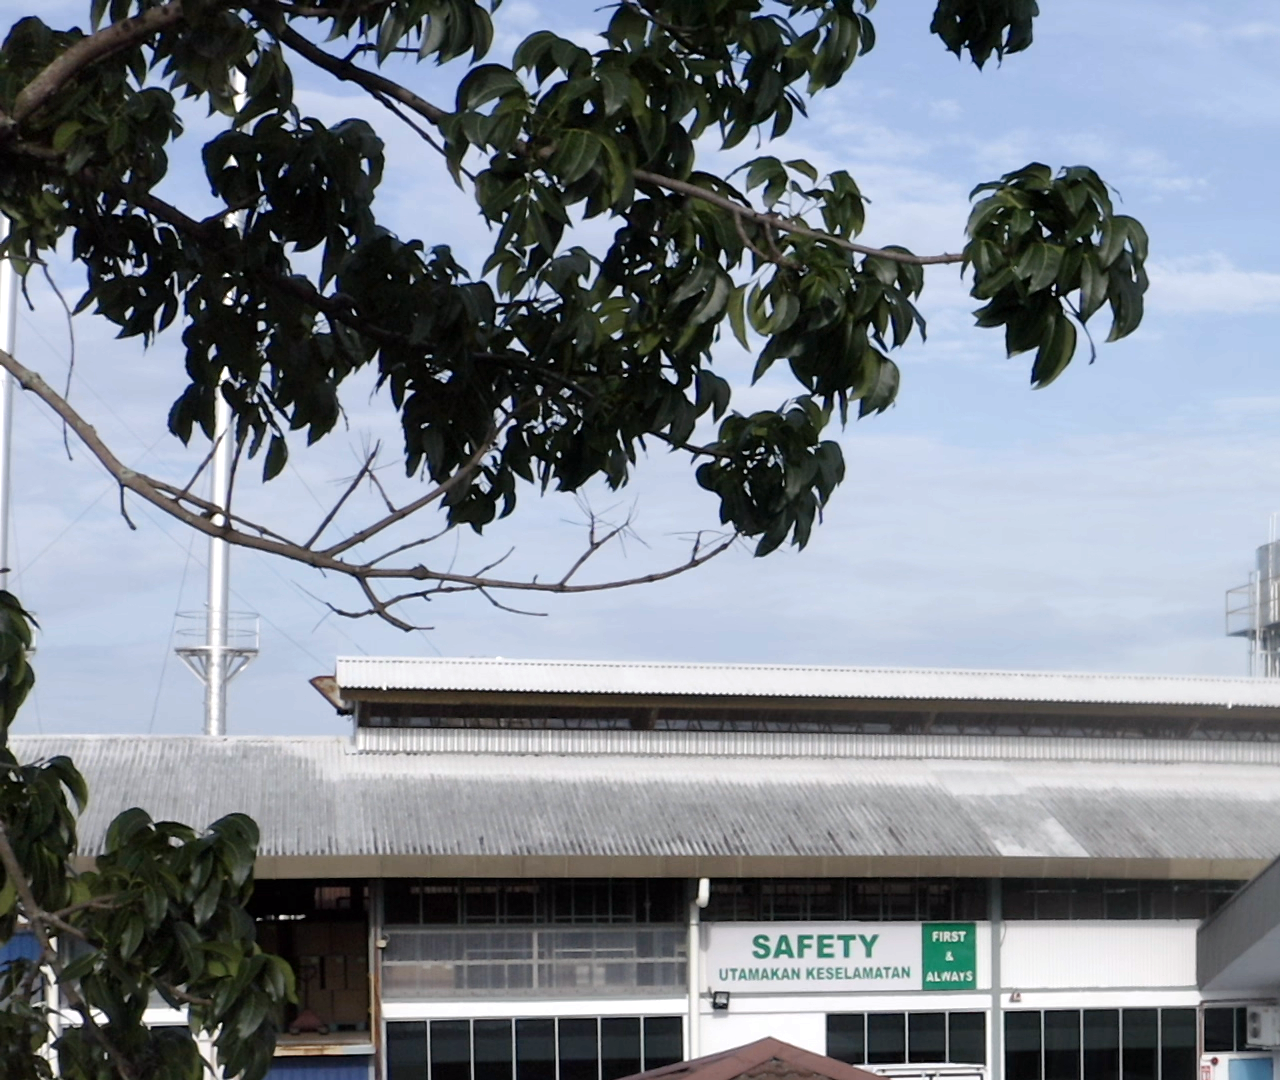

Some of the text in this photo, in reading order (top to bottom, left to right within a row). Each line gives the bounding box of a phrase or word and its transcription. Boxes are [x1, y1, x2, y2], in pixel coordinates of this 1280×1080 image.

[931, 930, 966, 943] FIRST
[751, 934, 880, 959] SAFETY
[945, 951, 954, 962] &
[718, 966, 911, 981] UTAMAKAN KESELAMATAN
[925, 970, 974, 983] ALWAYS
